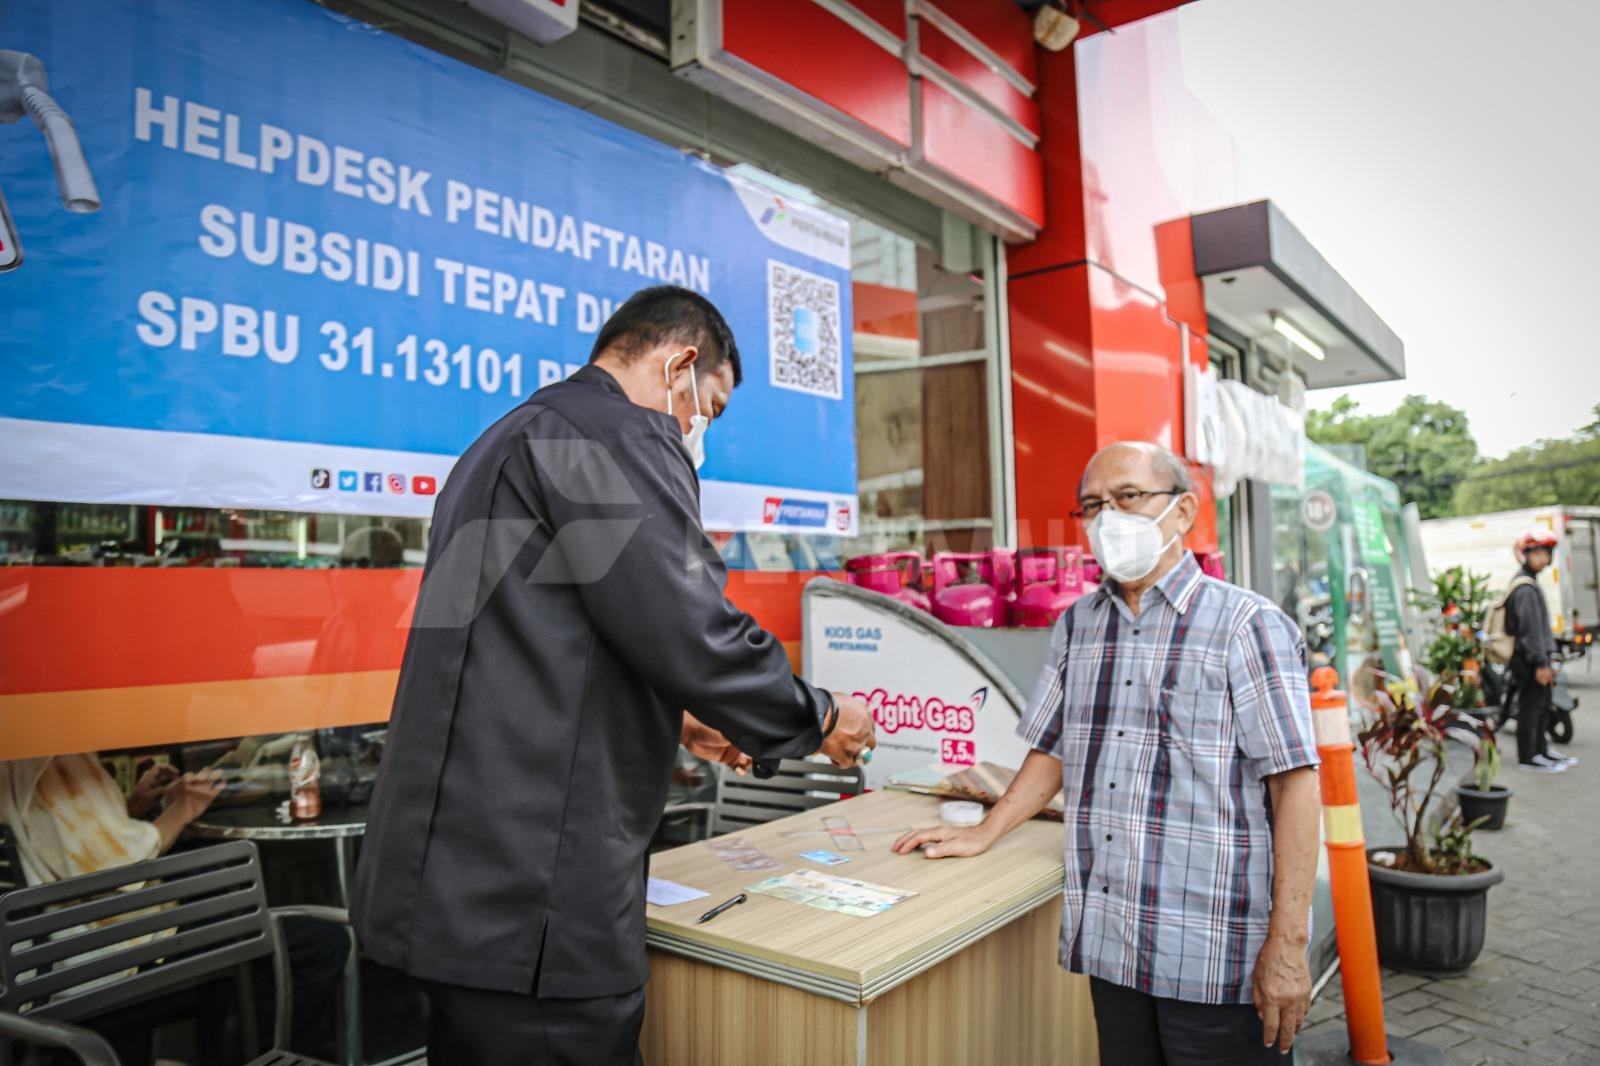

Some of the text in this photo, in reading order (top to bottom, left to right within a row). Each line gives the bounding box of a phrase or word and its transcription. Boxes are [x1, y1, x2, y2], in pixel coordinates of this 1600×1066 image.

[134, 87, 711, 295] HELPDESK PENDAFTARAN
[199, 204, 420, 297] SUBSIDI
[434, 257, 566, 327] TEPAT
[136, 290, 299, 364] SPBU
[319, 320, 522, 397] 31.13101
[824, 626, 882, 640] KIOS GAS
[925, 698, 975, 733] Gas
